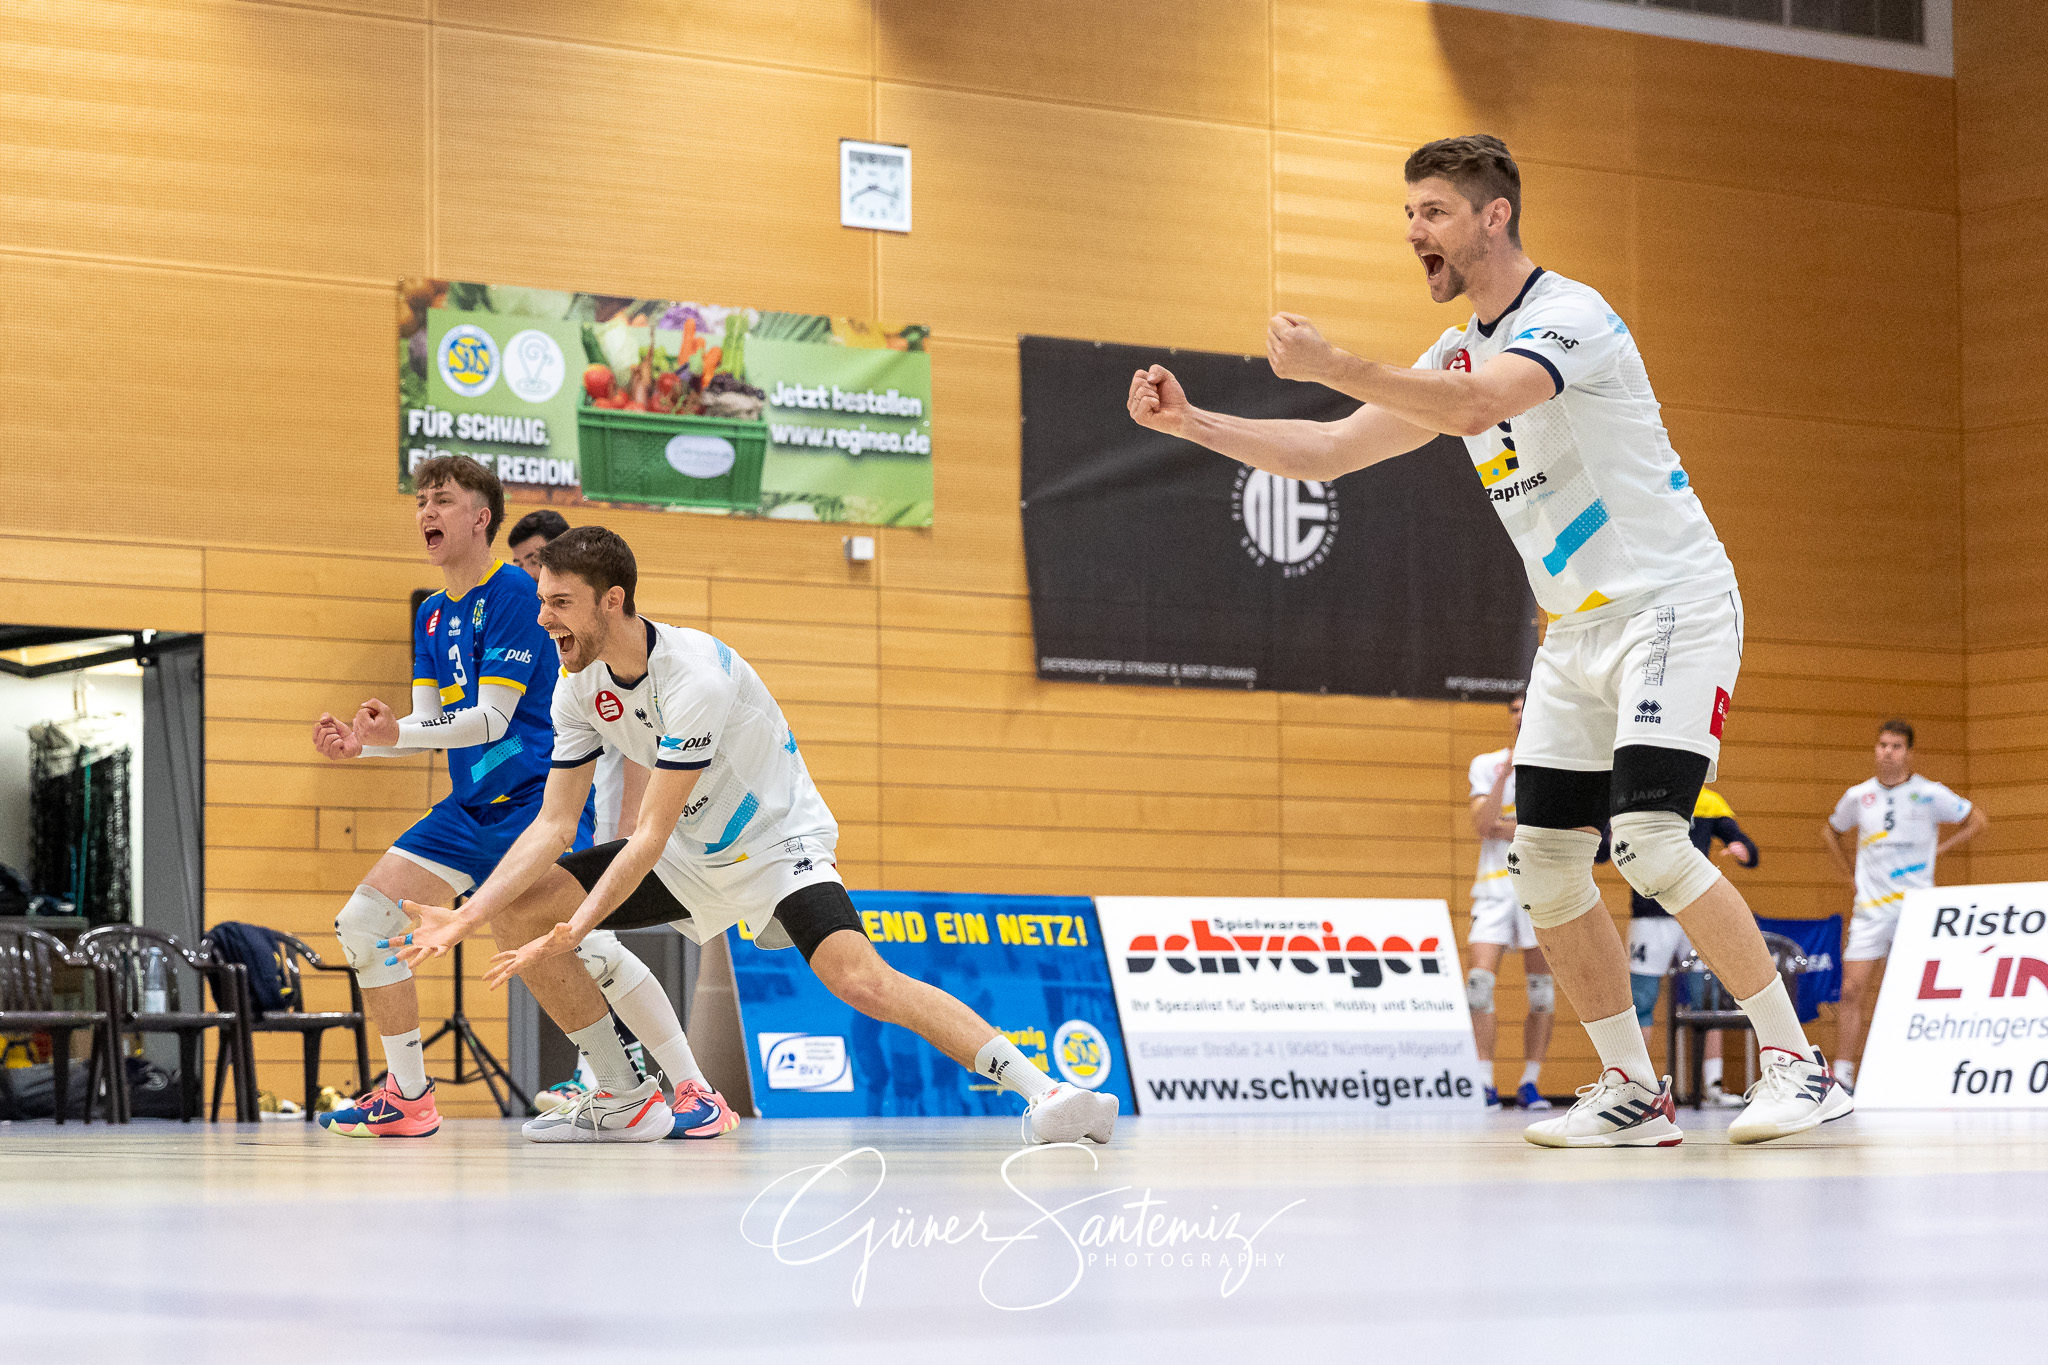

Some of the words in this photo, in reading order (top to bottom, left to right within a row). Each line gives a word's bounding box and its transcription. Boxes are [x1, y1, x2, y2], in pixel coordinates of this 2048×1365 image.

[770, 380, 830, 409] Jetzt
[832, 384, 923, 417] bestellen
[407, 405, 454, 438] FÜR
[456, 413, 550, 446] SCHWAIG.
[497, 453, 581, 486] REGION.
[1486, 471, 1548, 502] Zapfuss
[448, 644, 468, 687] 3
[504, 649, 533, 664] puls
[1634, 715, 1662, 724] errea
[1632, 788, 1667, 801] JAKO
[934, 911, 990, 944] EIN
[996, 913, 1089, 946] NETZ!
[1213, 918, 1319, 931] Spielwaren
[1932, 904, 2048, 937] Risto
[1125, 920, 1440, 988] schweiger
[1131, 1000, 1150, 1011] Ihr
[1155, 999, 1222, 1013] Spezialist
[1227, 1000, 1245, 1011] für
[1333, 1000, 1376, 1013] Hobby
[1382, 1000, 1406, 1011] und
[1411, 1000, 1454, 1011] Schule
[1148, 1070, 1473, 1106] www.schweiger.de
[1952, 1061, 2013, 1094] fon
